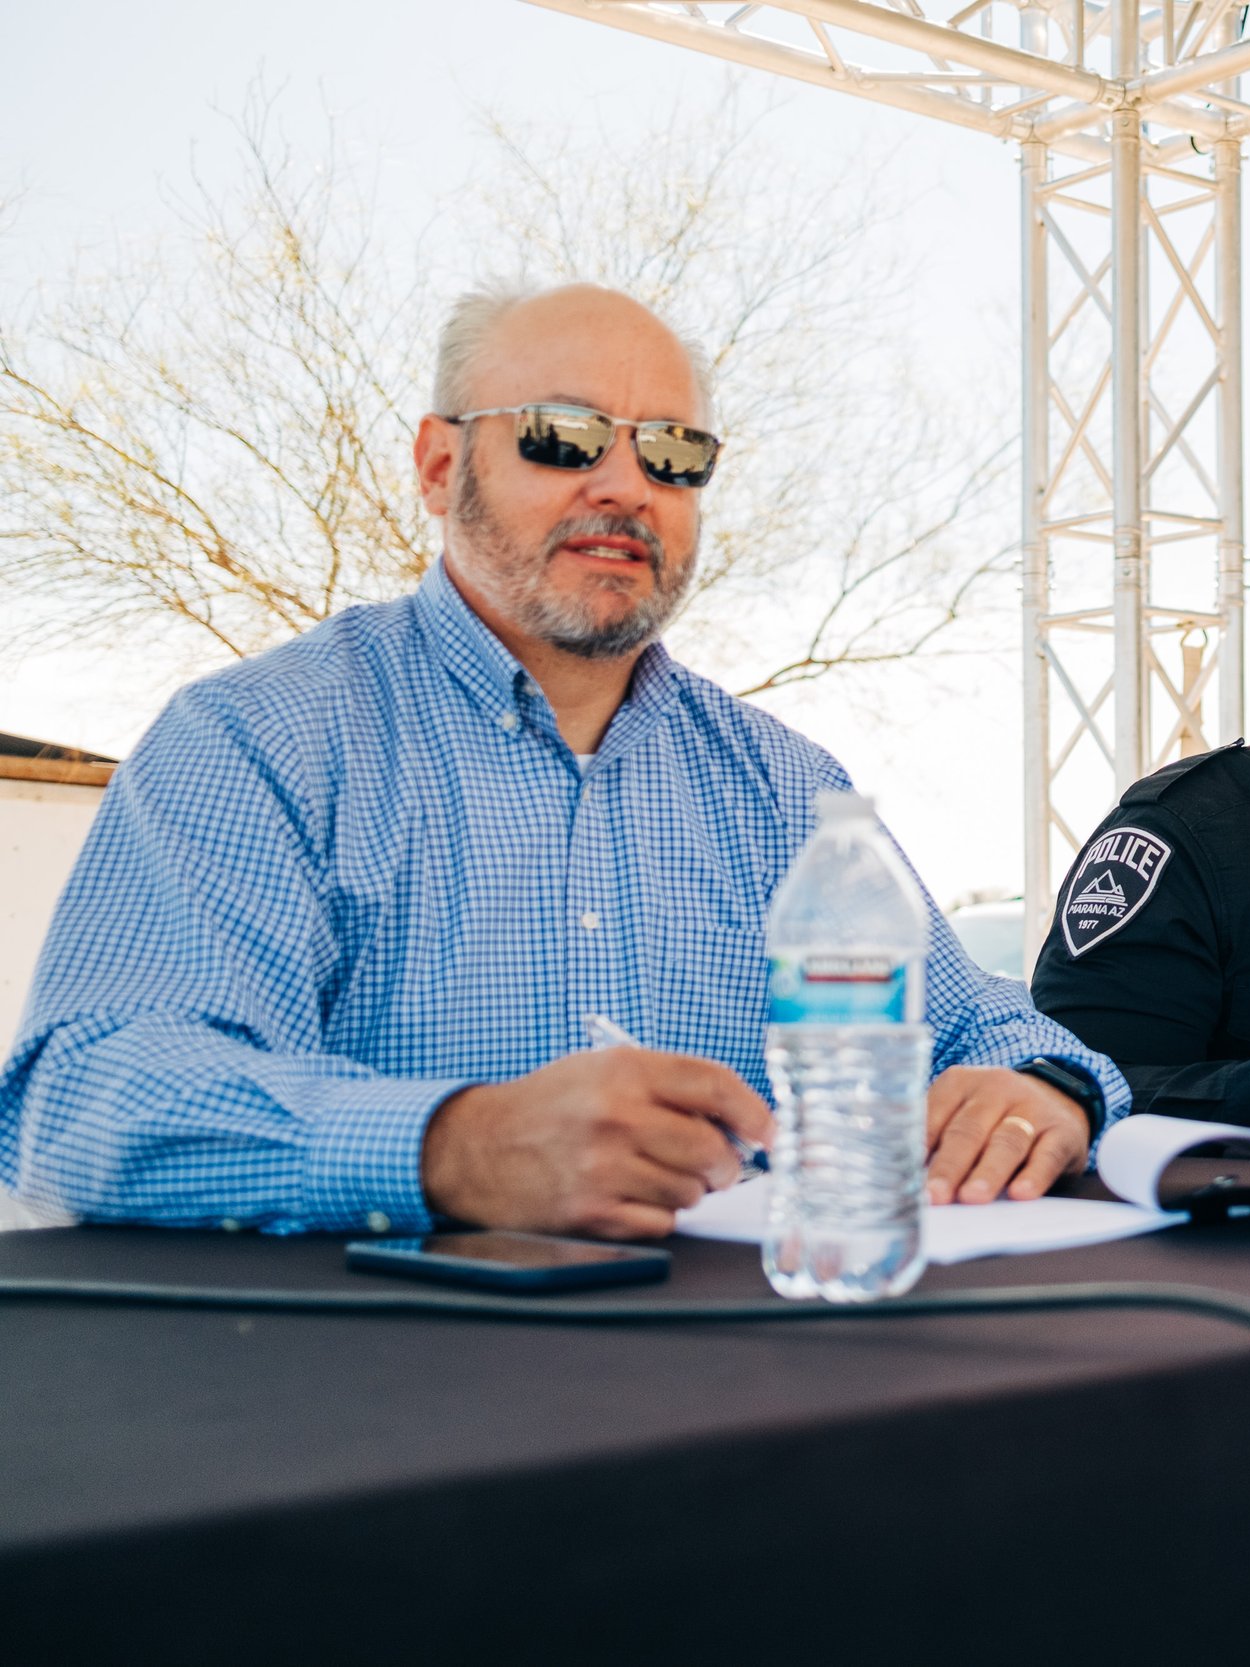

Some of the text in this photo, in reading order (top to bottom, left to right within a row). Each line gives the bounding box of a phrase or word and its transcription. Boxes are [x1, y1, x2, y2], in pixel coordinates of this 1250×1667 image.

[1078, 835, 1161, 881] POLICE
[1067, 904, 1125, 918] MARANA AZ
[1078, 919, 1099, 930] 1977
